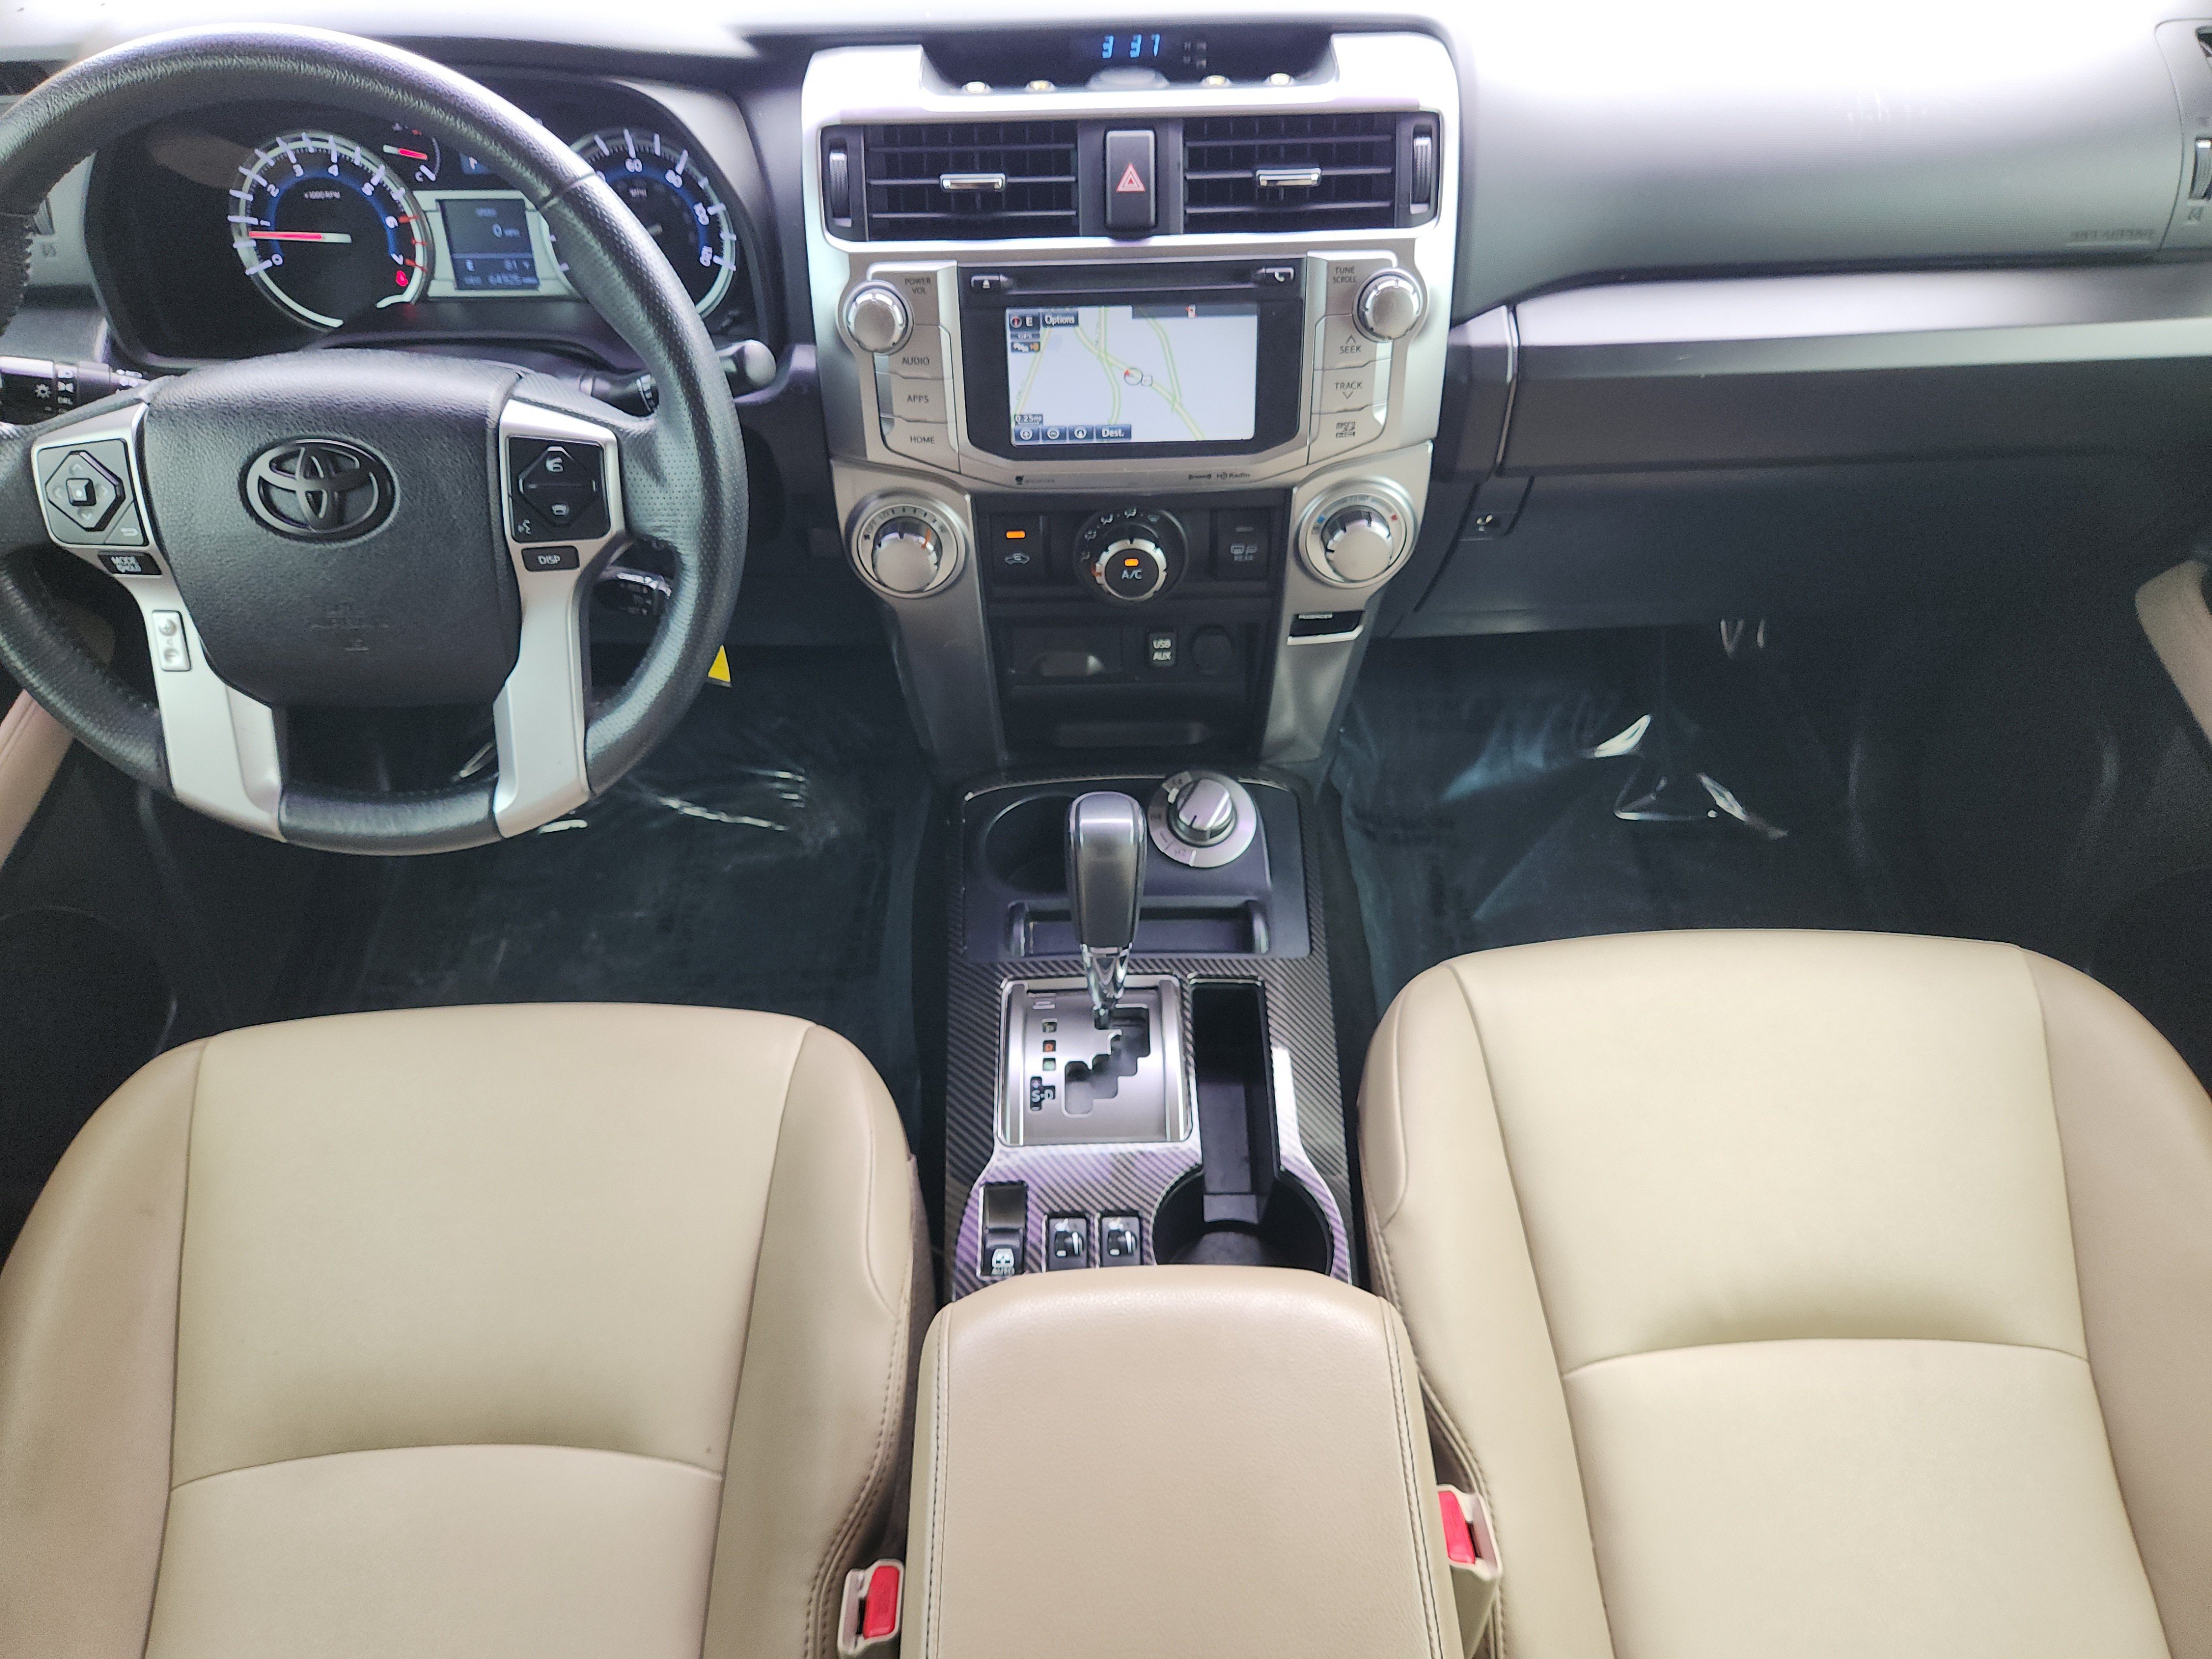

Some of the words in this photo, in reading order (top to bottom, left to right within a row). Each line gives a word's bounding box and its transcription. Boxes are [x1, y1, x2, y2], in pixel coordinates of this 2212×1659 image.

[293, 164, 304, 177] 3
[328, 164, 339, 176] 4
[625, 158, 643, 173] 60
[665, 169, 682, 188] 80
[267, 184, 279, 197] 2
[385, 216, 398, 228] 6
[492, 223, 503, 238] 0
[272, 254, 283, 265] 0
[390, 253, 404, 265] 7
[1026, 316, 1034, 327] E
[1045, 314, 1075, 326] Options
[1340, 345, 1362, 354] SEEK
[902, 357, 930, 366] AUDIO
[1334, 382, 1363, 390] TRACK
[907, 395, 930, 403] APPS
[909, 436, 935, 444] HOME
[111, 556, 138, 565] MODE
[537, 555, 561, 565] DISP
[1121, 569, 1142, 579] A/C
[1152, 639, 1171, 649] USB
[1152, 651, 1171, 660] AUX
